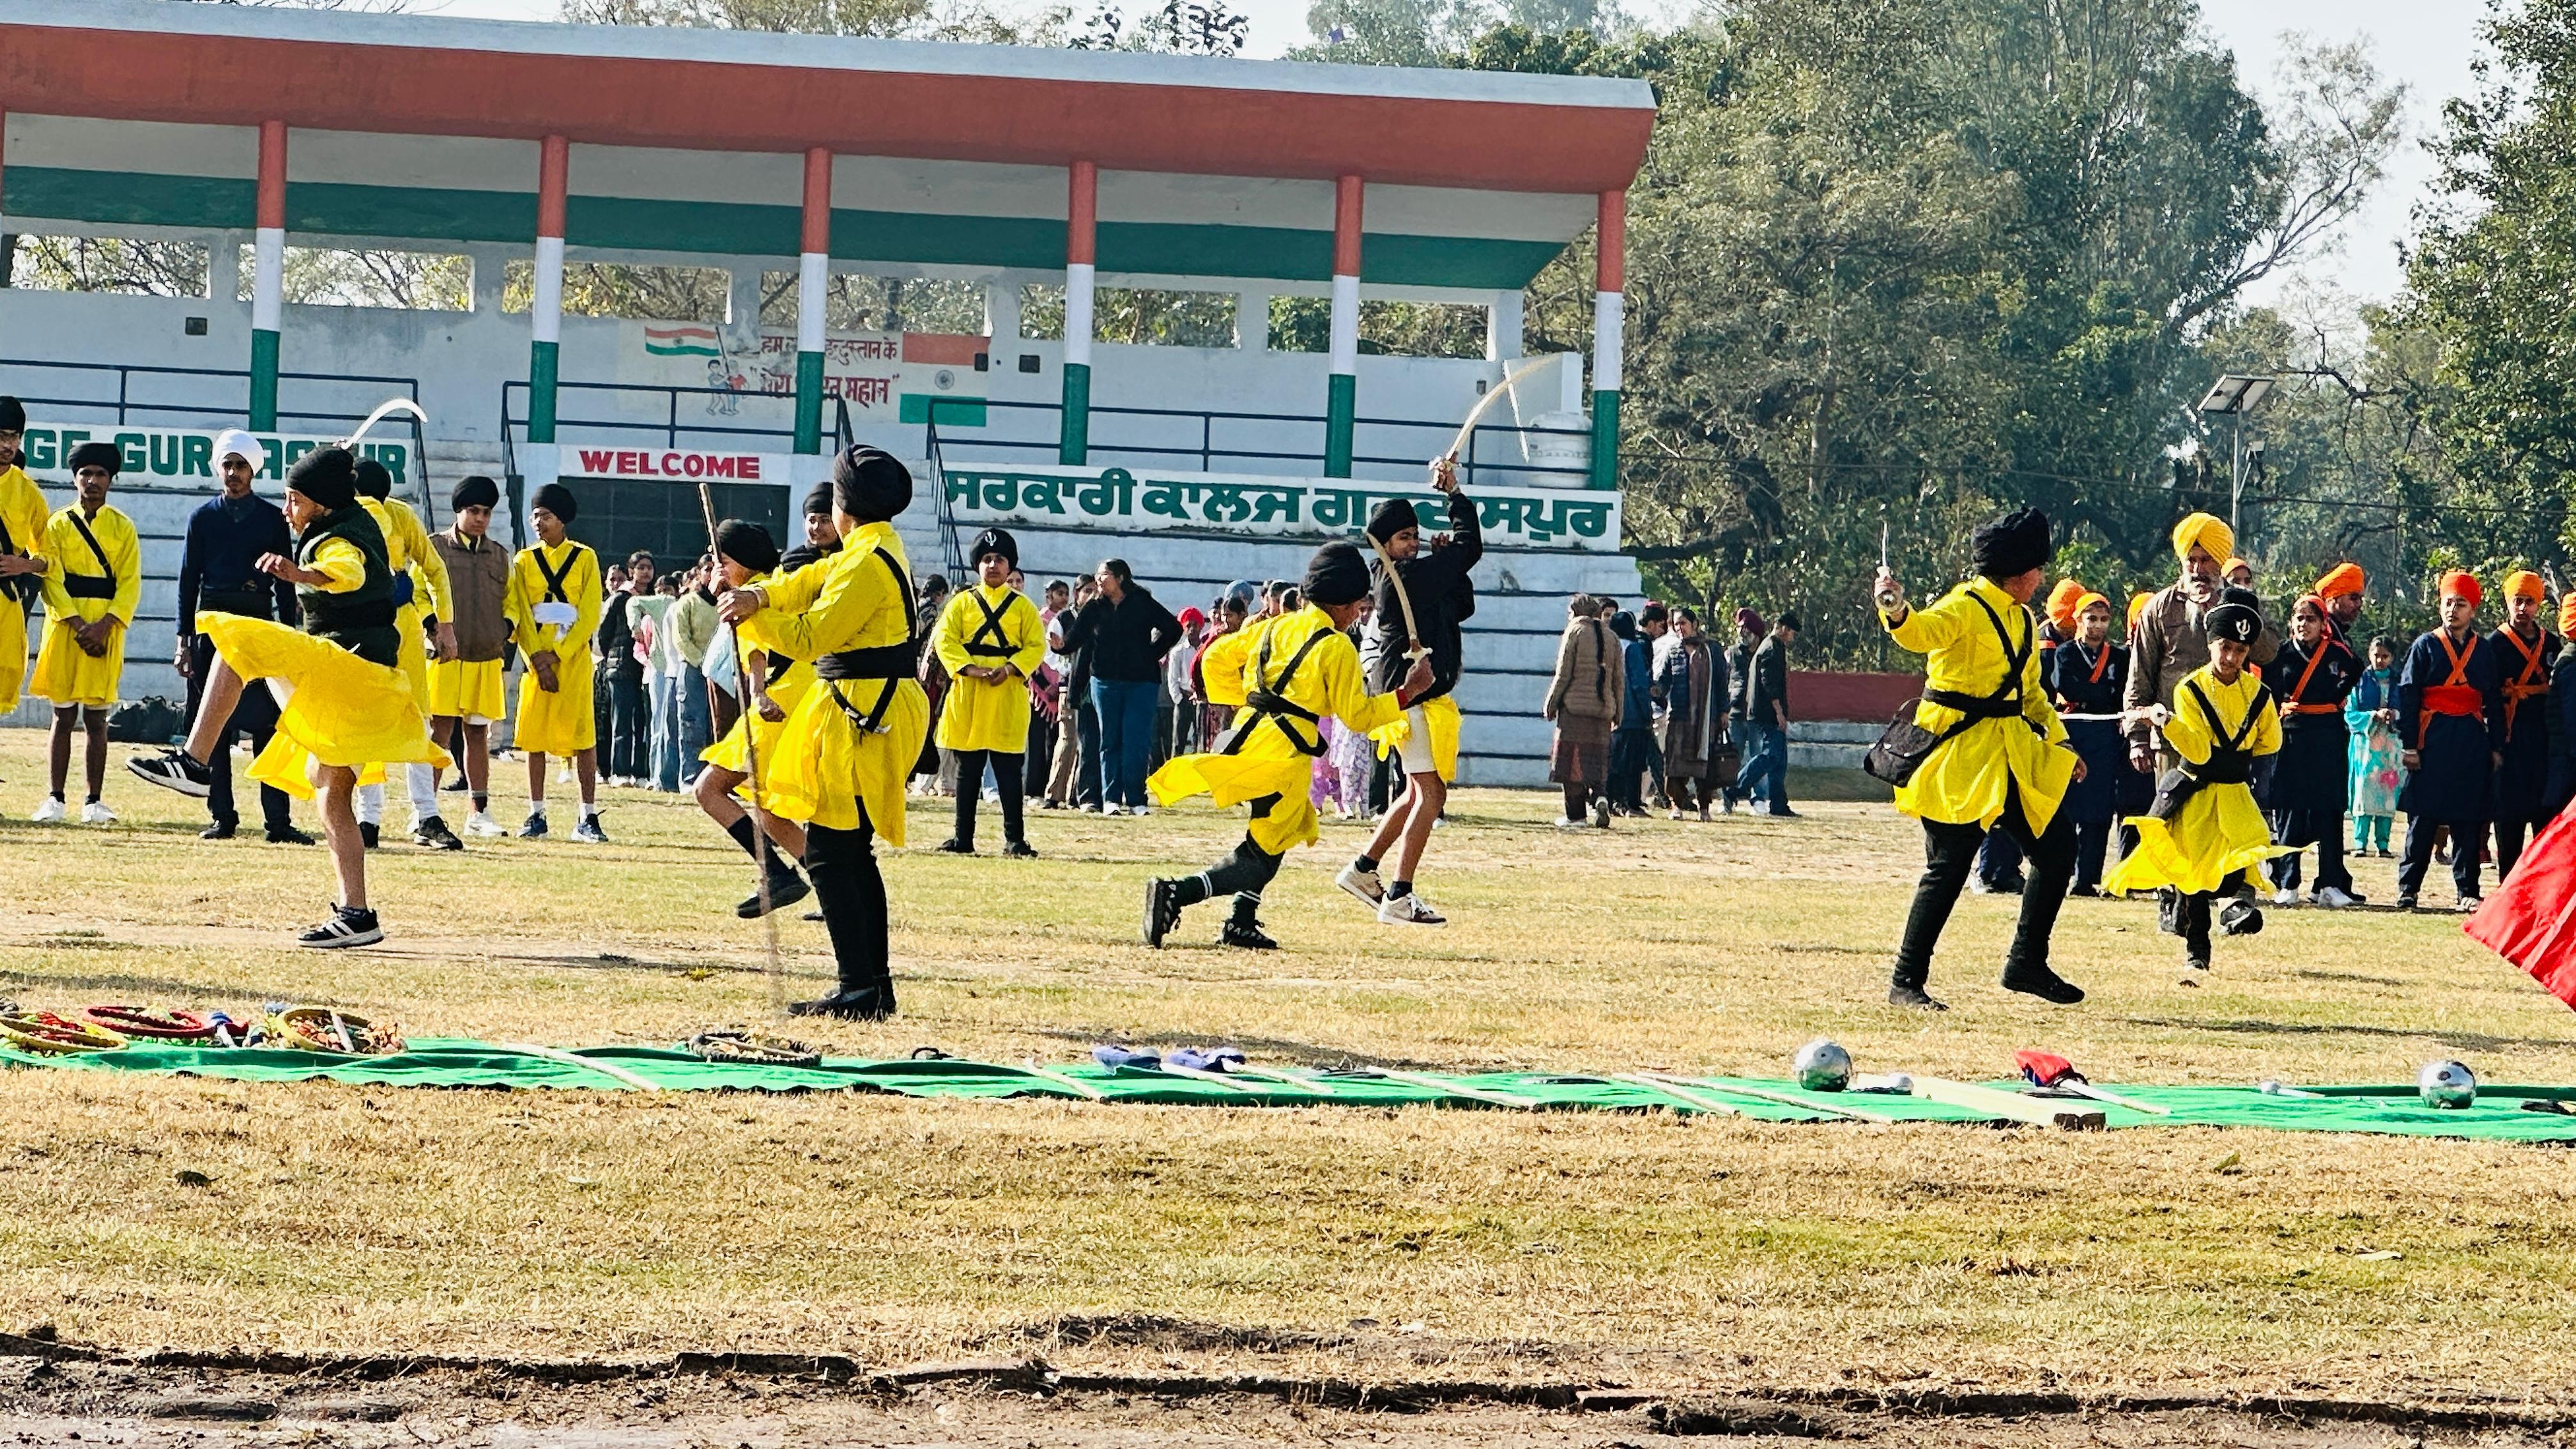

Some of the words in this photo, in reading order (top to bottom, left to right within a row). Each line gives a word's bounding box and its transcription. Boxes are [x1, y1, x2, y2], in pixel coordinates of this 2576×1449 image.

[884, 335, 898, 360] के
[579, 450, 760, 479] WELCOME
[943, 467, 1138, 516] ਸਰਕਾਰੀ
[1141, 479, 1308, 523] ਕਾਲਜ
[1312, 487, 1614, 542] ਗੁਦਸਪੁਰ
